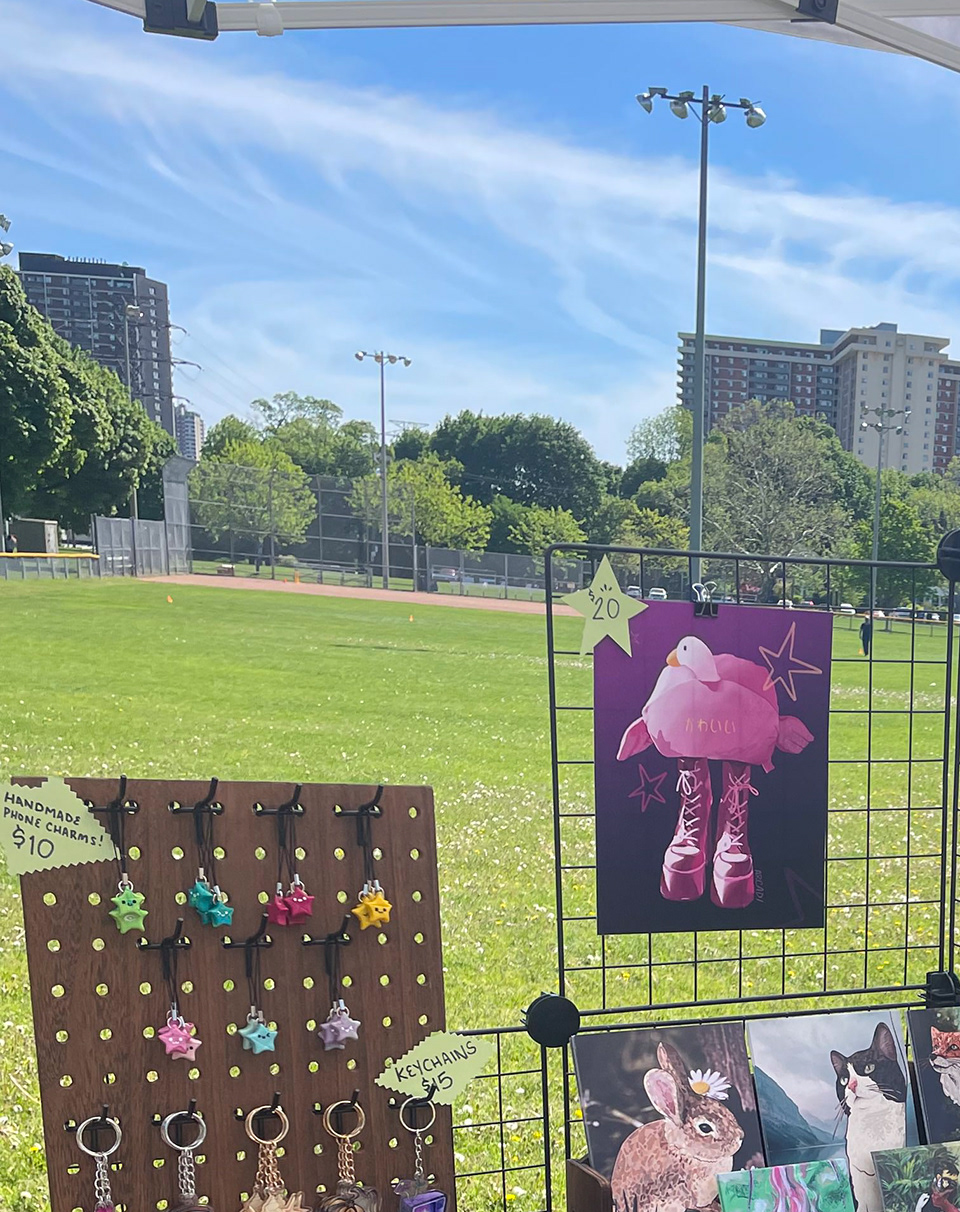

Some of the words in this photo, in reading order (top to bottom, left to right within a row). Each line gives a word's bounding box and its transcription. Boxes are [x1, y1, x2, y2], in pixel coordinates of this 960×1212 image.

[588, 588, 620, 620] $20
[4, 791, 81, 826] HANDMADE
[3, 807, 42, 829] PHONE
[46, 822, 104, 847] CHARMS!
[12, 824, 55, 859] $10
[395, 1041, 477, 1082] KEYCHAINS
[421, 1071, 454, 1094] $15
